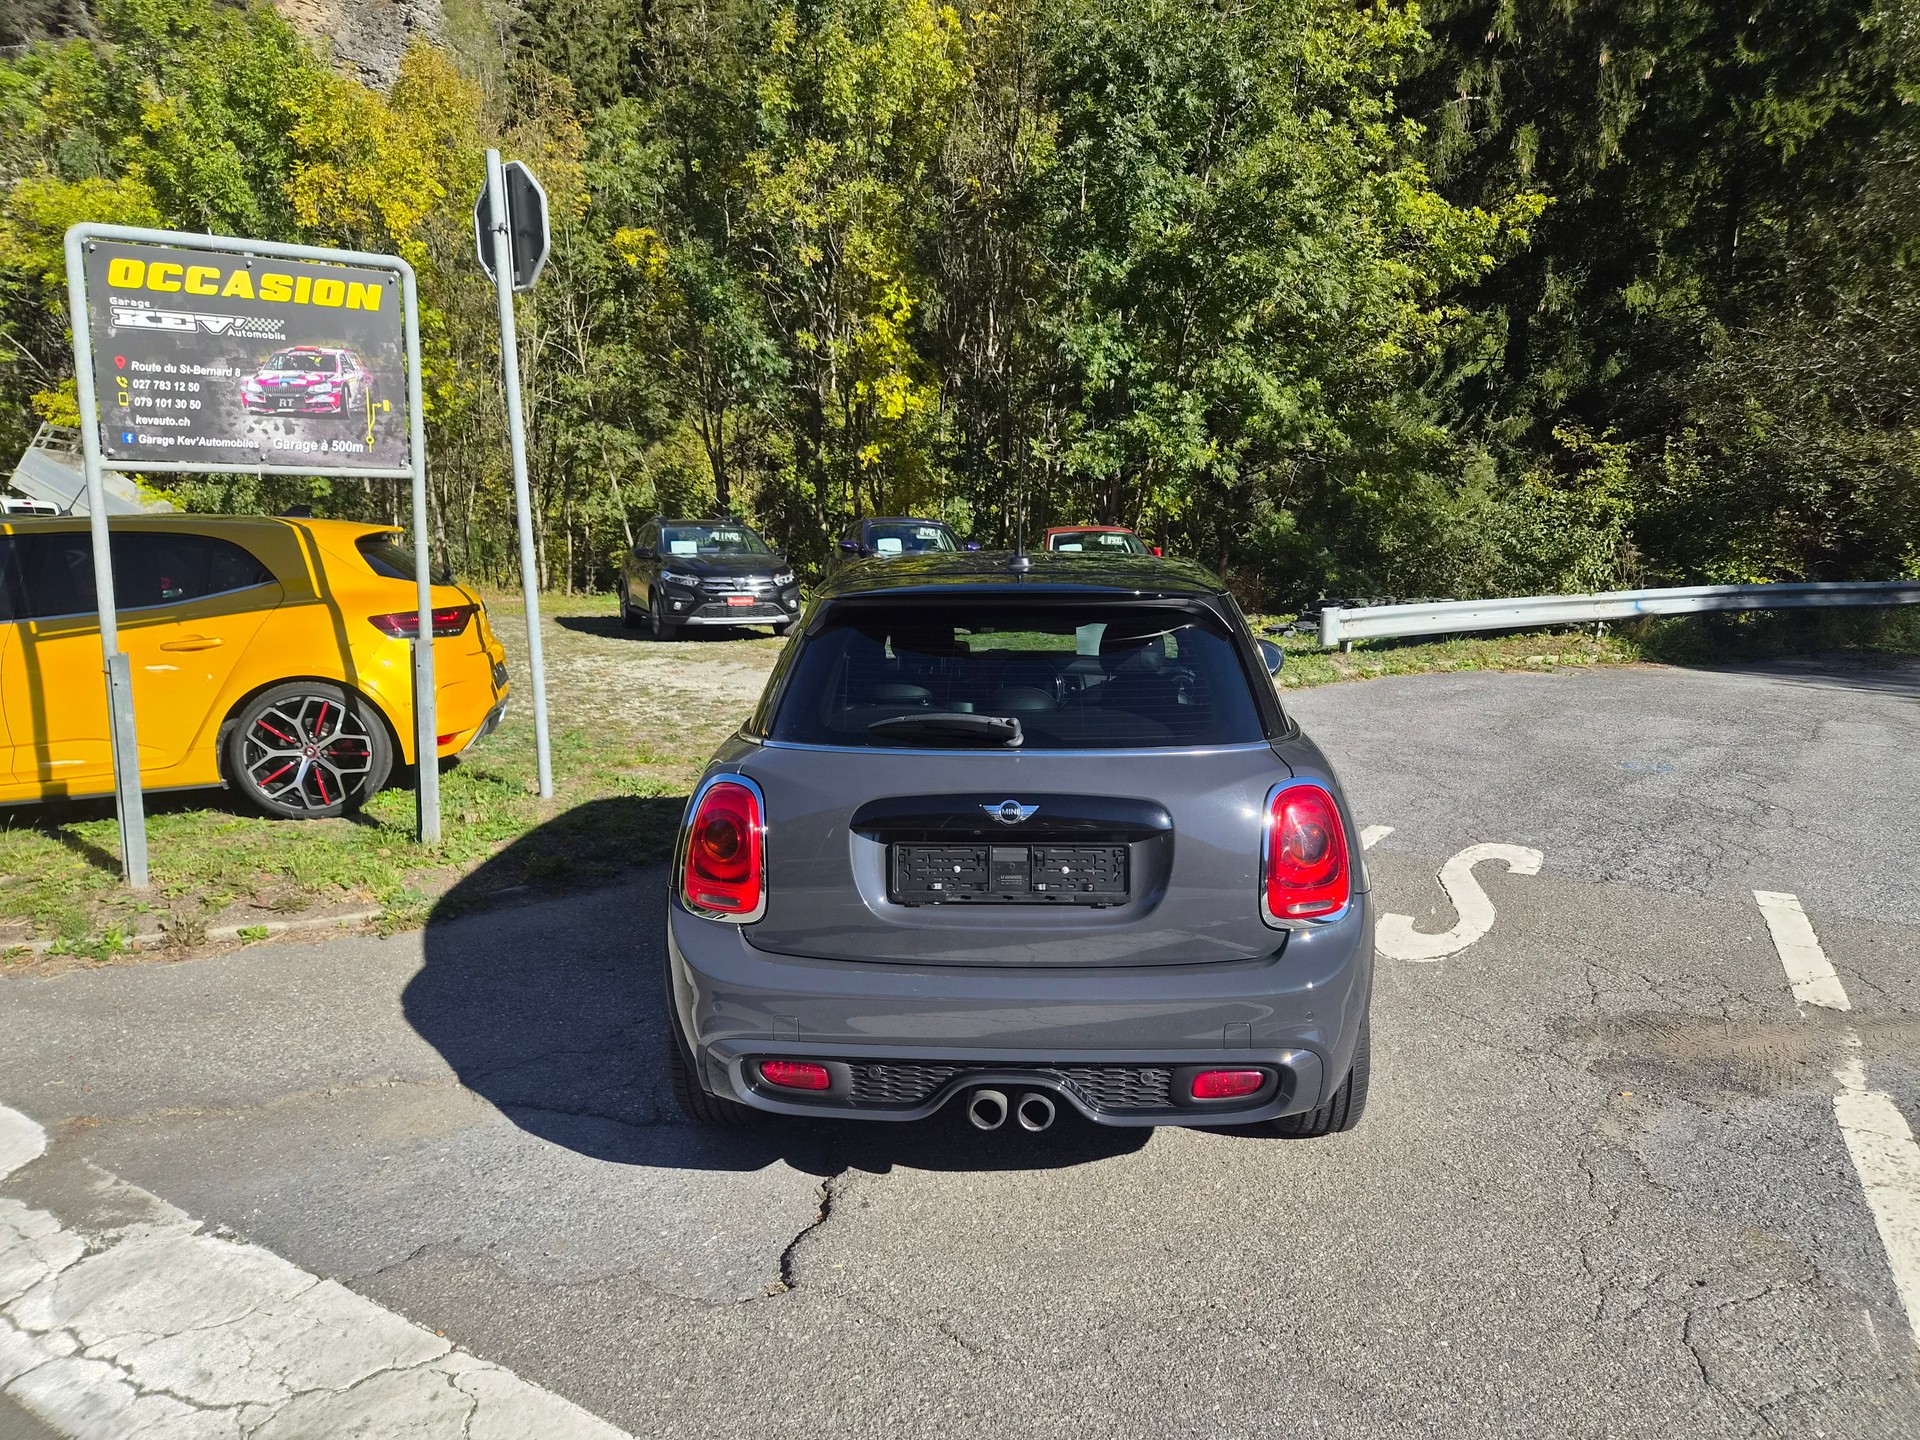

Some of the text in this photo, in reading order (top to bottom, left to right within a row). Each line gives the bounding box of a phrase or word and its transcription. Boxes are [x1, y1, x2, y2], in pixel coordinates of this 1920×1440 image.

[107, 258, 383, 311] OCCASION
[109, 296, 151, 309] Garage
[227, 329, 287, 341] Automobile
[131, 361, 241, 377] Route du St-Bernard 8
[132, 379, 200, 392] 027 783 12 50
[134, 397, 202, 410] 079 101 30 50
[279, 398, 294, 407] RT
[135, 415, 191, 427] kevauto.ch
[138, 434, 260, 449] Garage Kev'Automobiles
[273, 437, 364, 453] Garage à 500m
